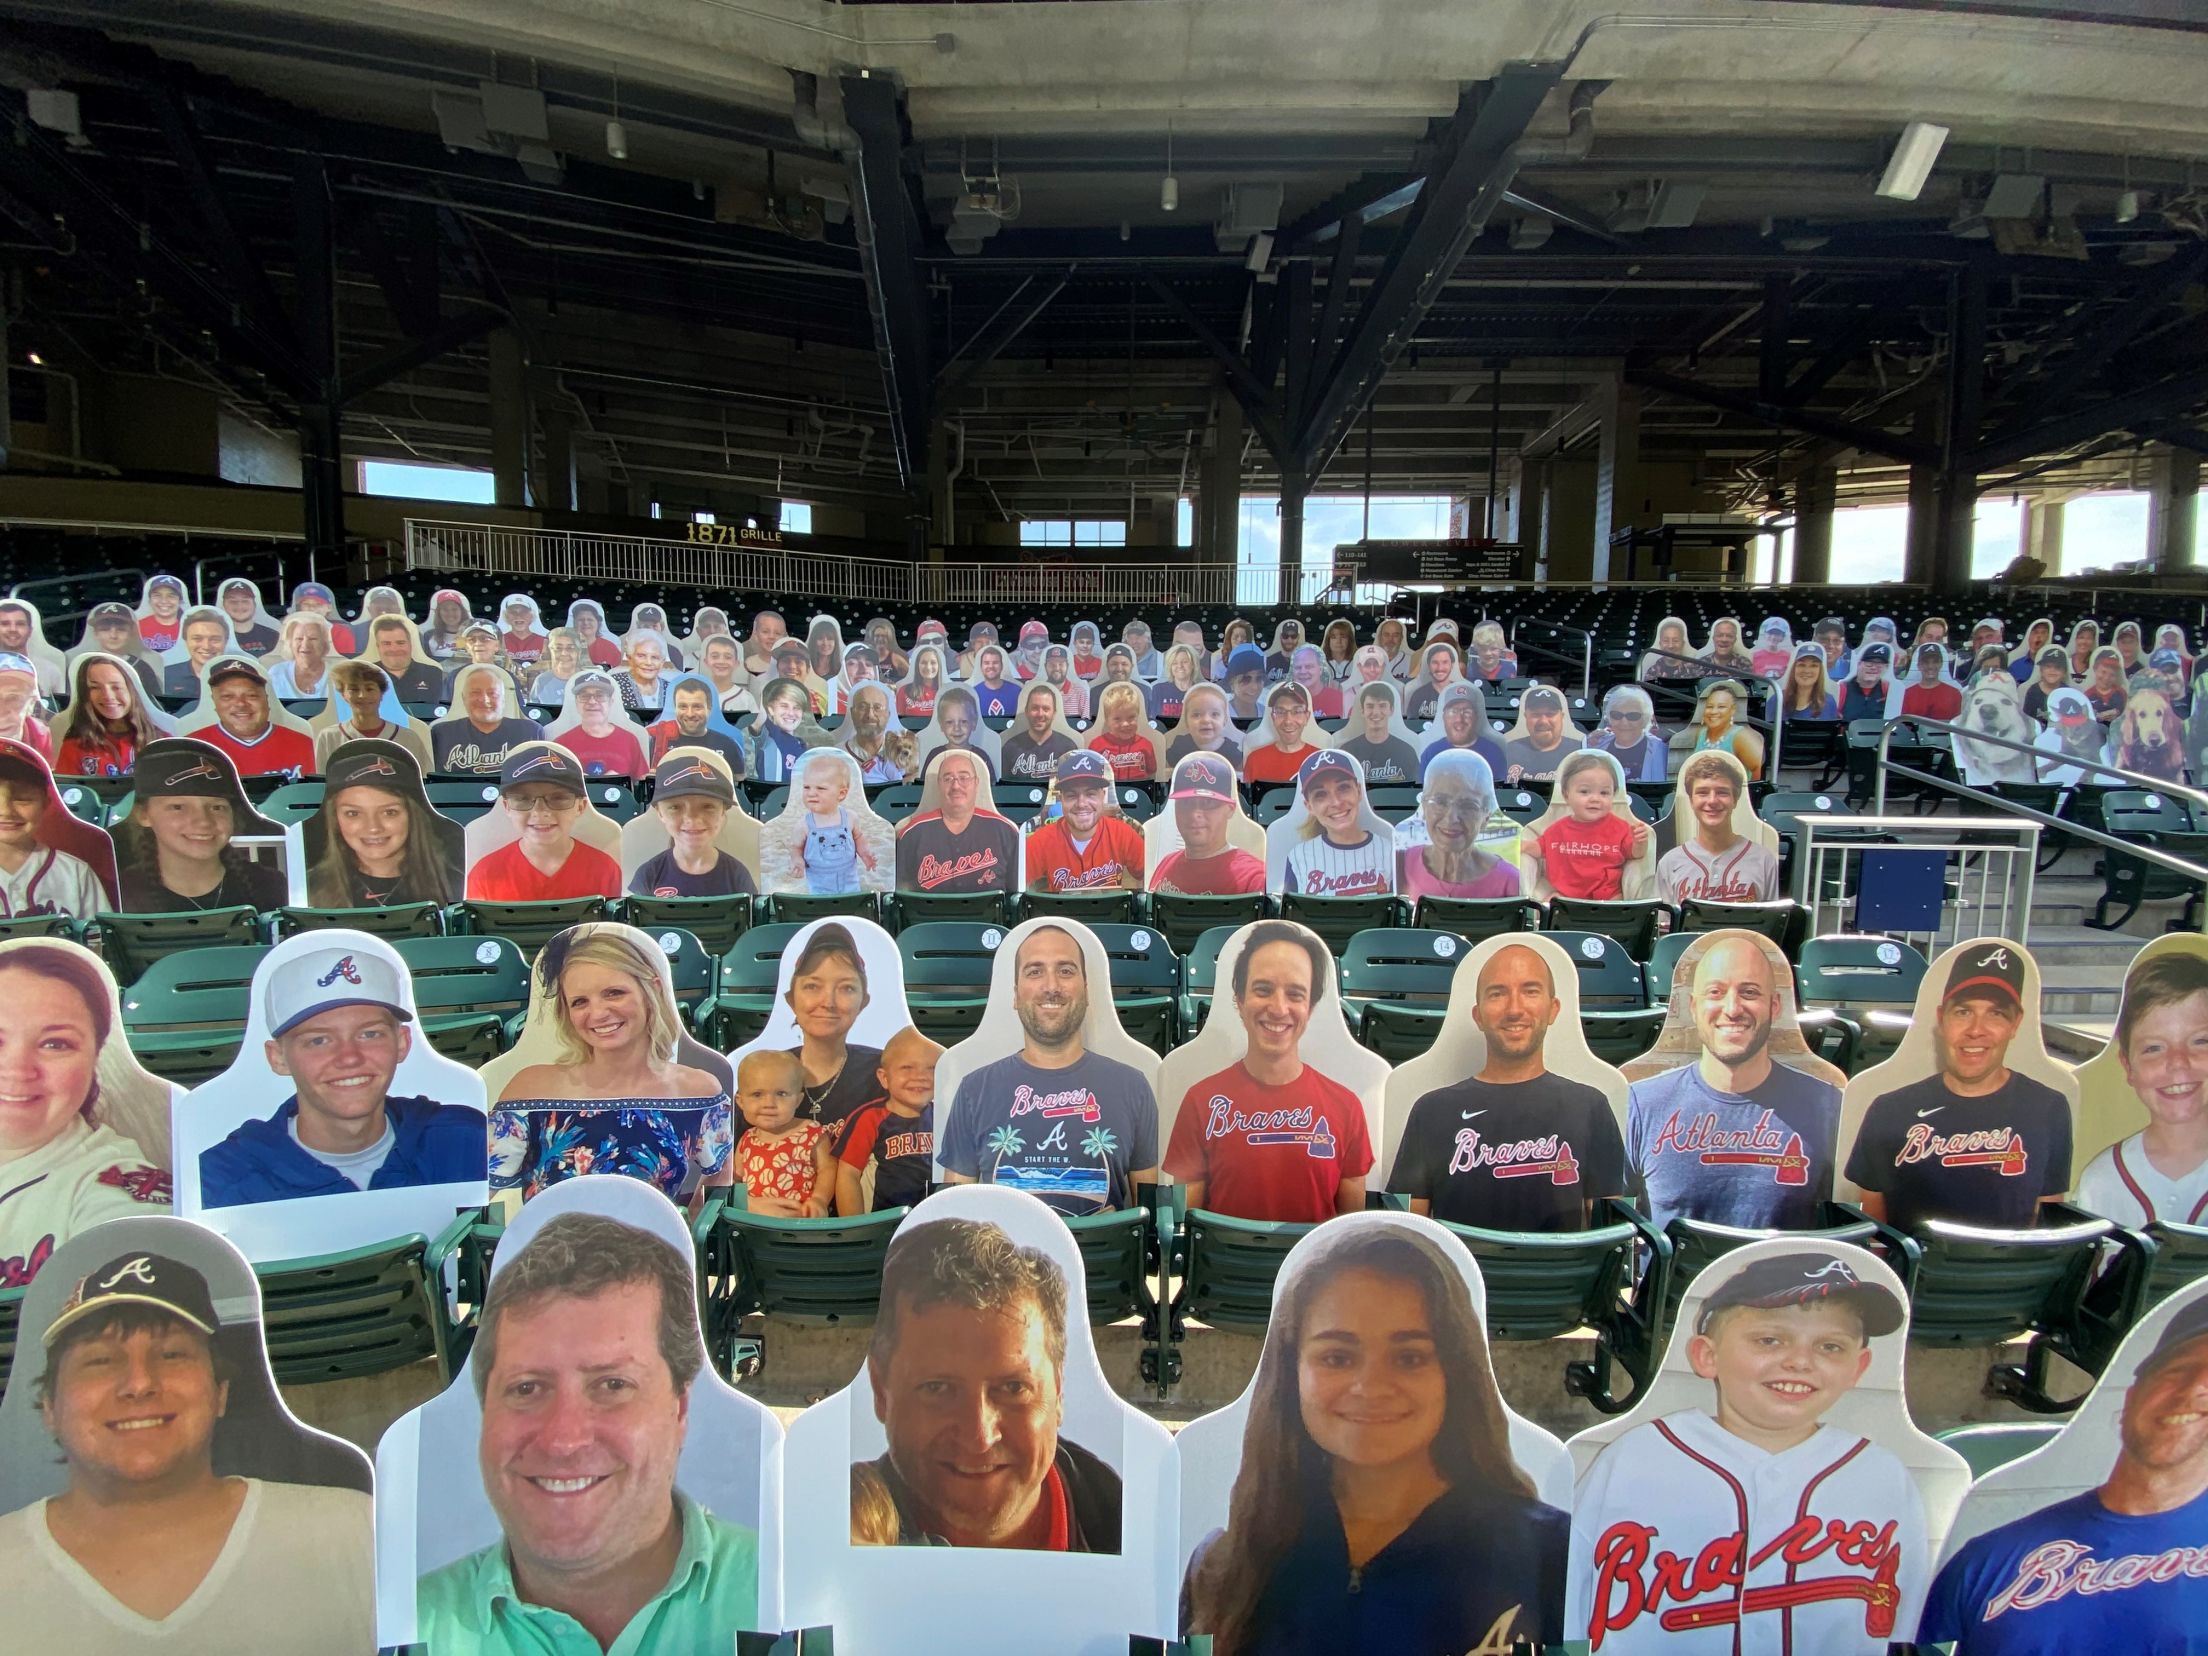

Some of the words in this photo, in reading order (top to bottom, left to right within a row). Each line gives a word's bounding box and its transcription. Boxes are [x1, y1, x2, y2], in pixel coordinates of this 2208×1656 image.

[686, 522, 738, 546] 1871
[740, 528, 783, 542] GRILLE
[1551, 841, 1619, 854] FAIRHOPE
[918, 848, 997, 885] Braves
[1053, 859, 1117, 889] Braves
[1306, 868, 1377, 896] Braves
[1677, 870, 1749, 902] Atlanta
[1010, 1084, 1086, 1118] Braves
[1205, 1094, 1313, 1141] Braves
[1651, 1108, 1783, 1156] Atlanta
[1895, 1122, 2013, 1168] Braves
[1024, 1155, 1046, 1164] START
[1047, 1155, 1061, 1164] THE
[1063, 1155, 1071, 1164] W.
[1448, 1127, 1560, 1176] Braves
[1588, 1516, 1900, 1653] Braves
